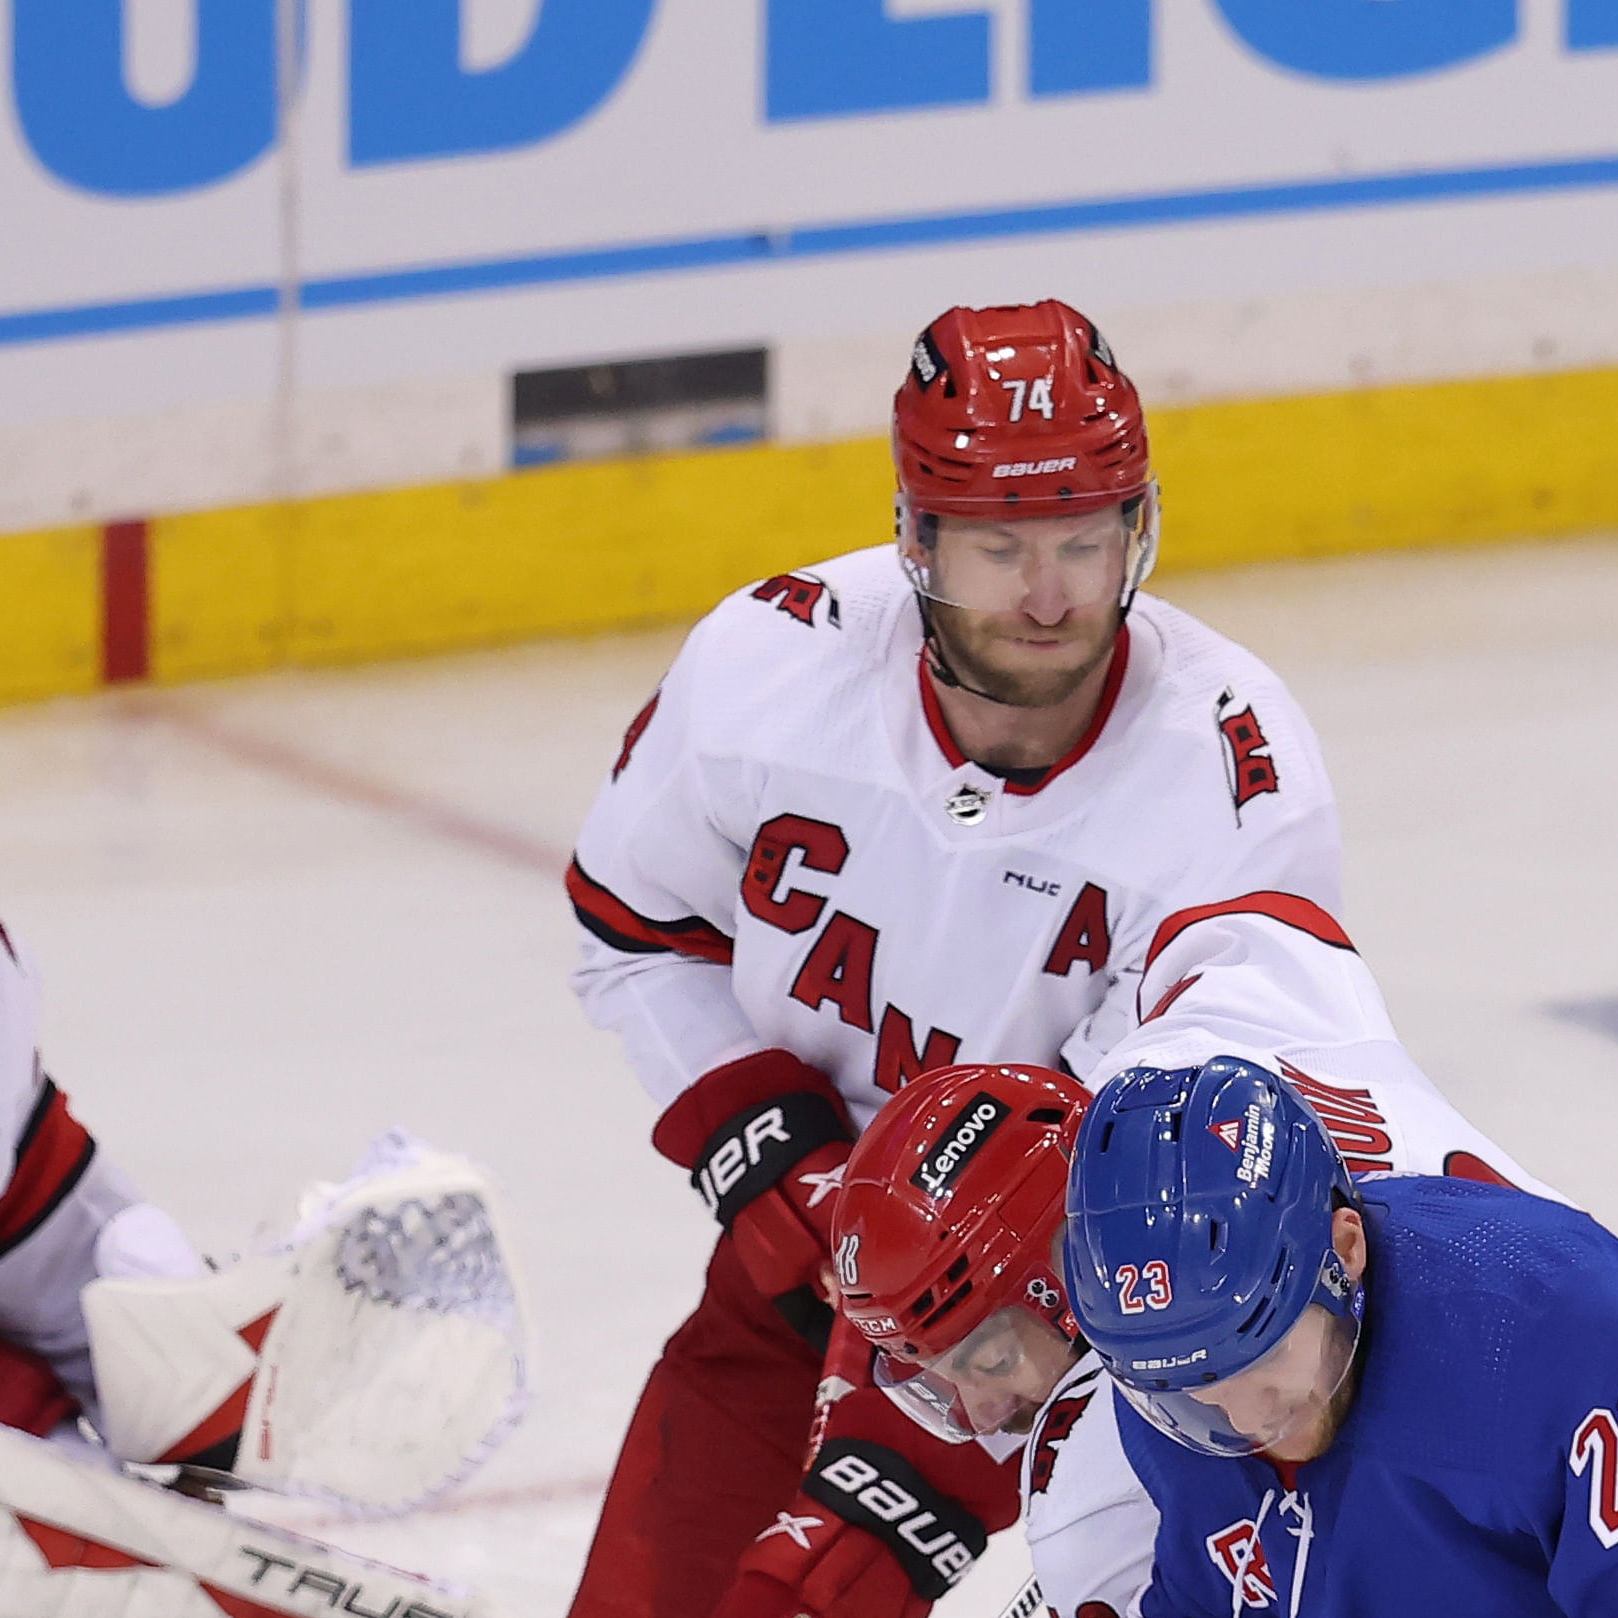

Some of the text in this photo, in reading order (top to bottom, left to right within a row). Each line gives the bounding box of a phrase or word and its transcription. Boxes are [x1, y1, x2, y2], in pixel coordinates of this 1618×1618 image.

[1000, 377, 1055, 423] 74
[992, 456, 1077, 479] BAUER
[1043, 880, 1113, 978] A
[921, 1103, 996, 1192] Lenovo
[1236, 1104, 1261, 1183] Benjamin
[1115, 1260, 1173, 1315] 23
[1132, 1348, 1207, 1370] BAUER
